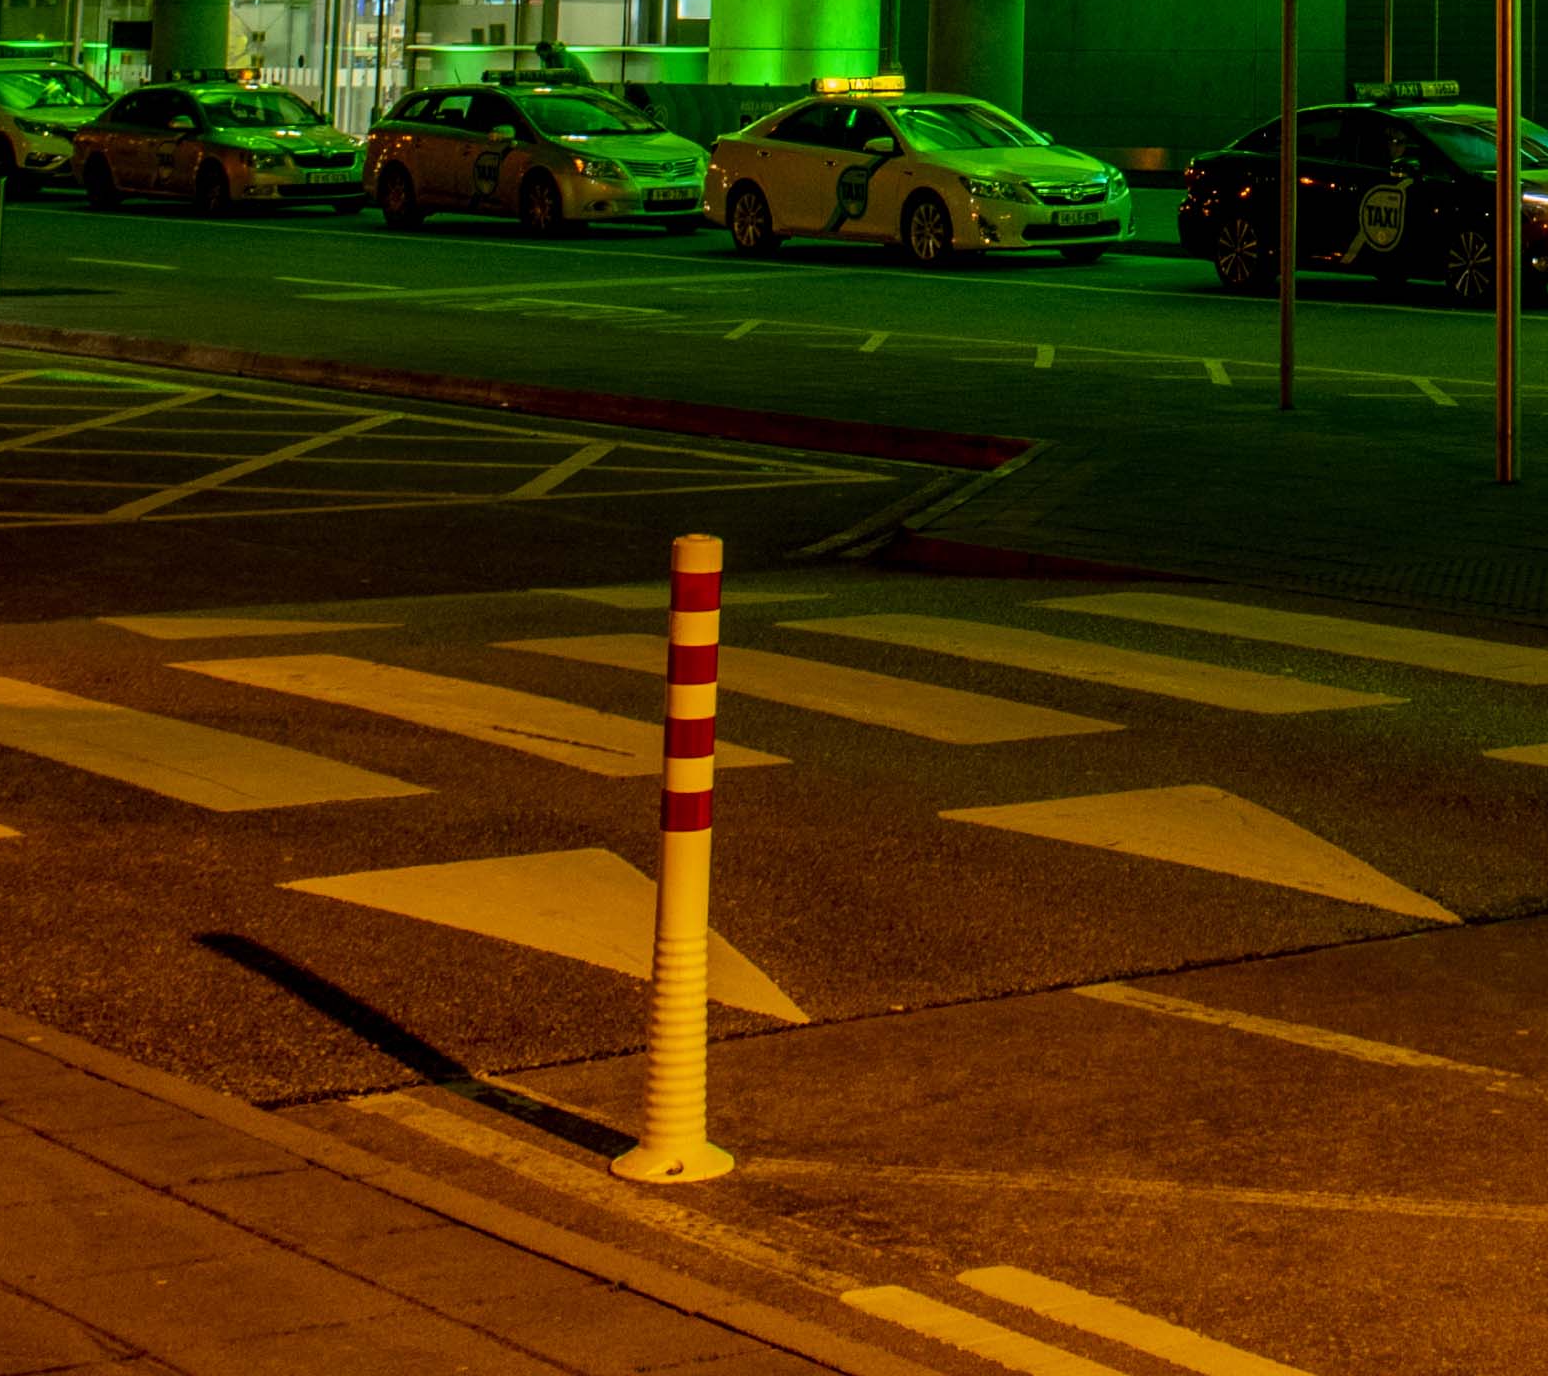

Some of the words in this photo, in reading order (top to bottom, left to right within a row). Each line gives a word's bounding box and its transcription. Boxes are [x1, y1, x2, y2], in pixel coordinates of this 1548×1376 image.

[850, 78, 872, 90] TAXI
[1395, 83, 1418, 97] TAXI
[842, 182, 865, 200] TAXI
[1367, 205, 1397, 227] TAXI
